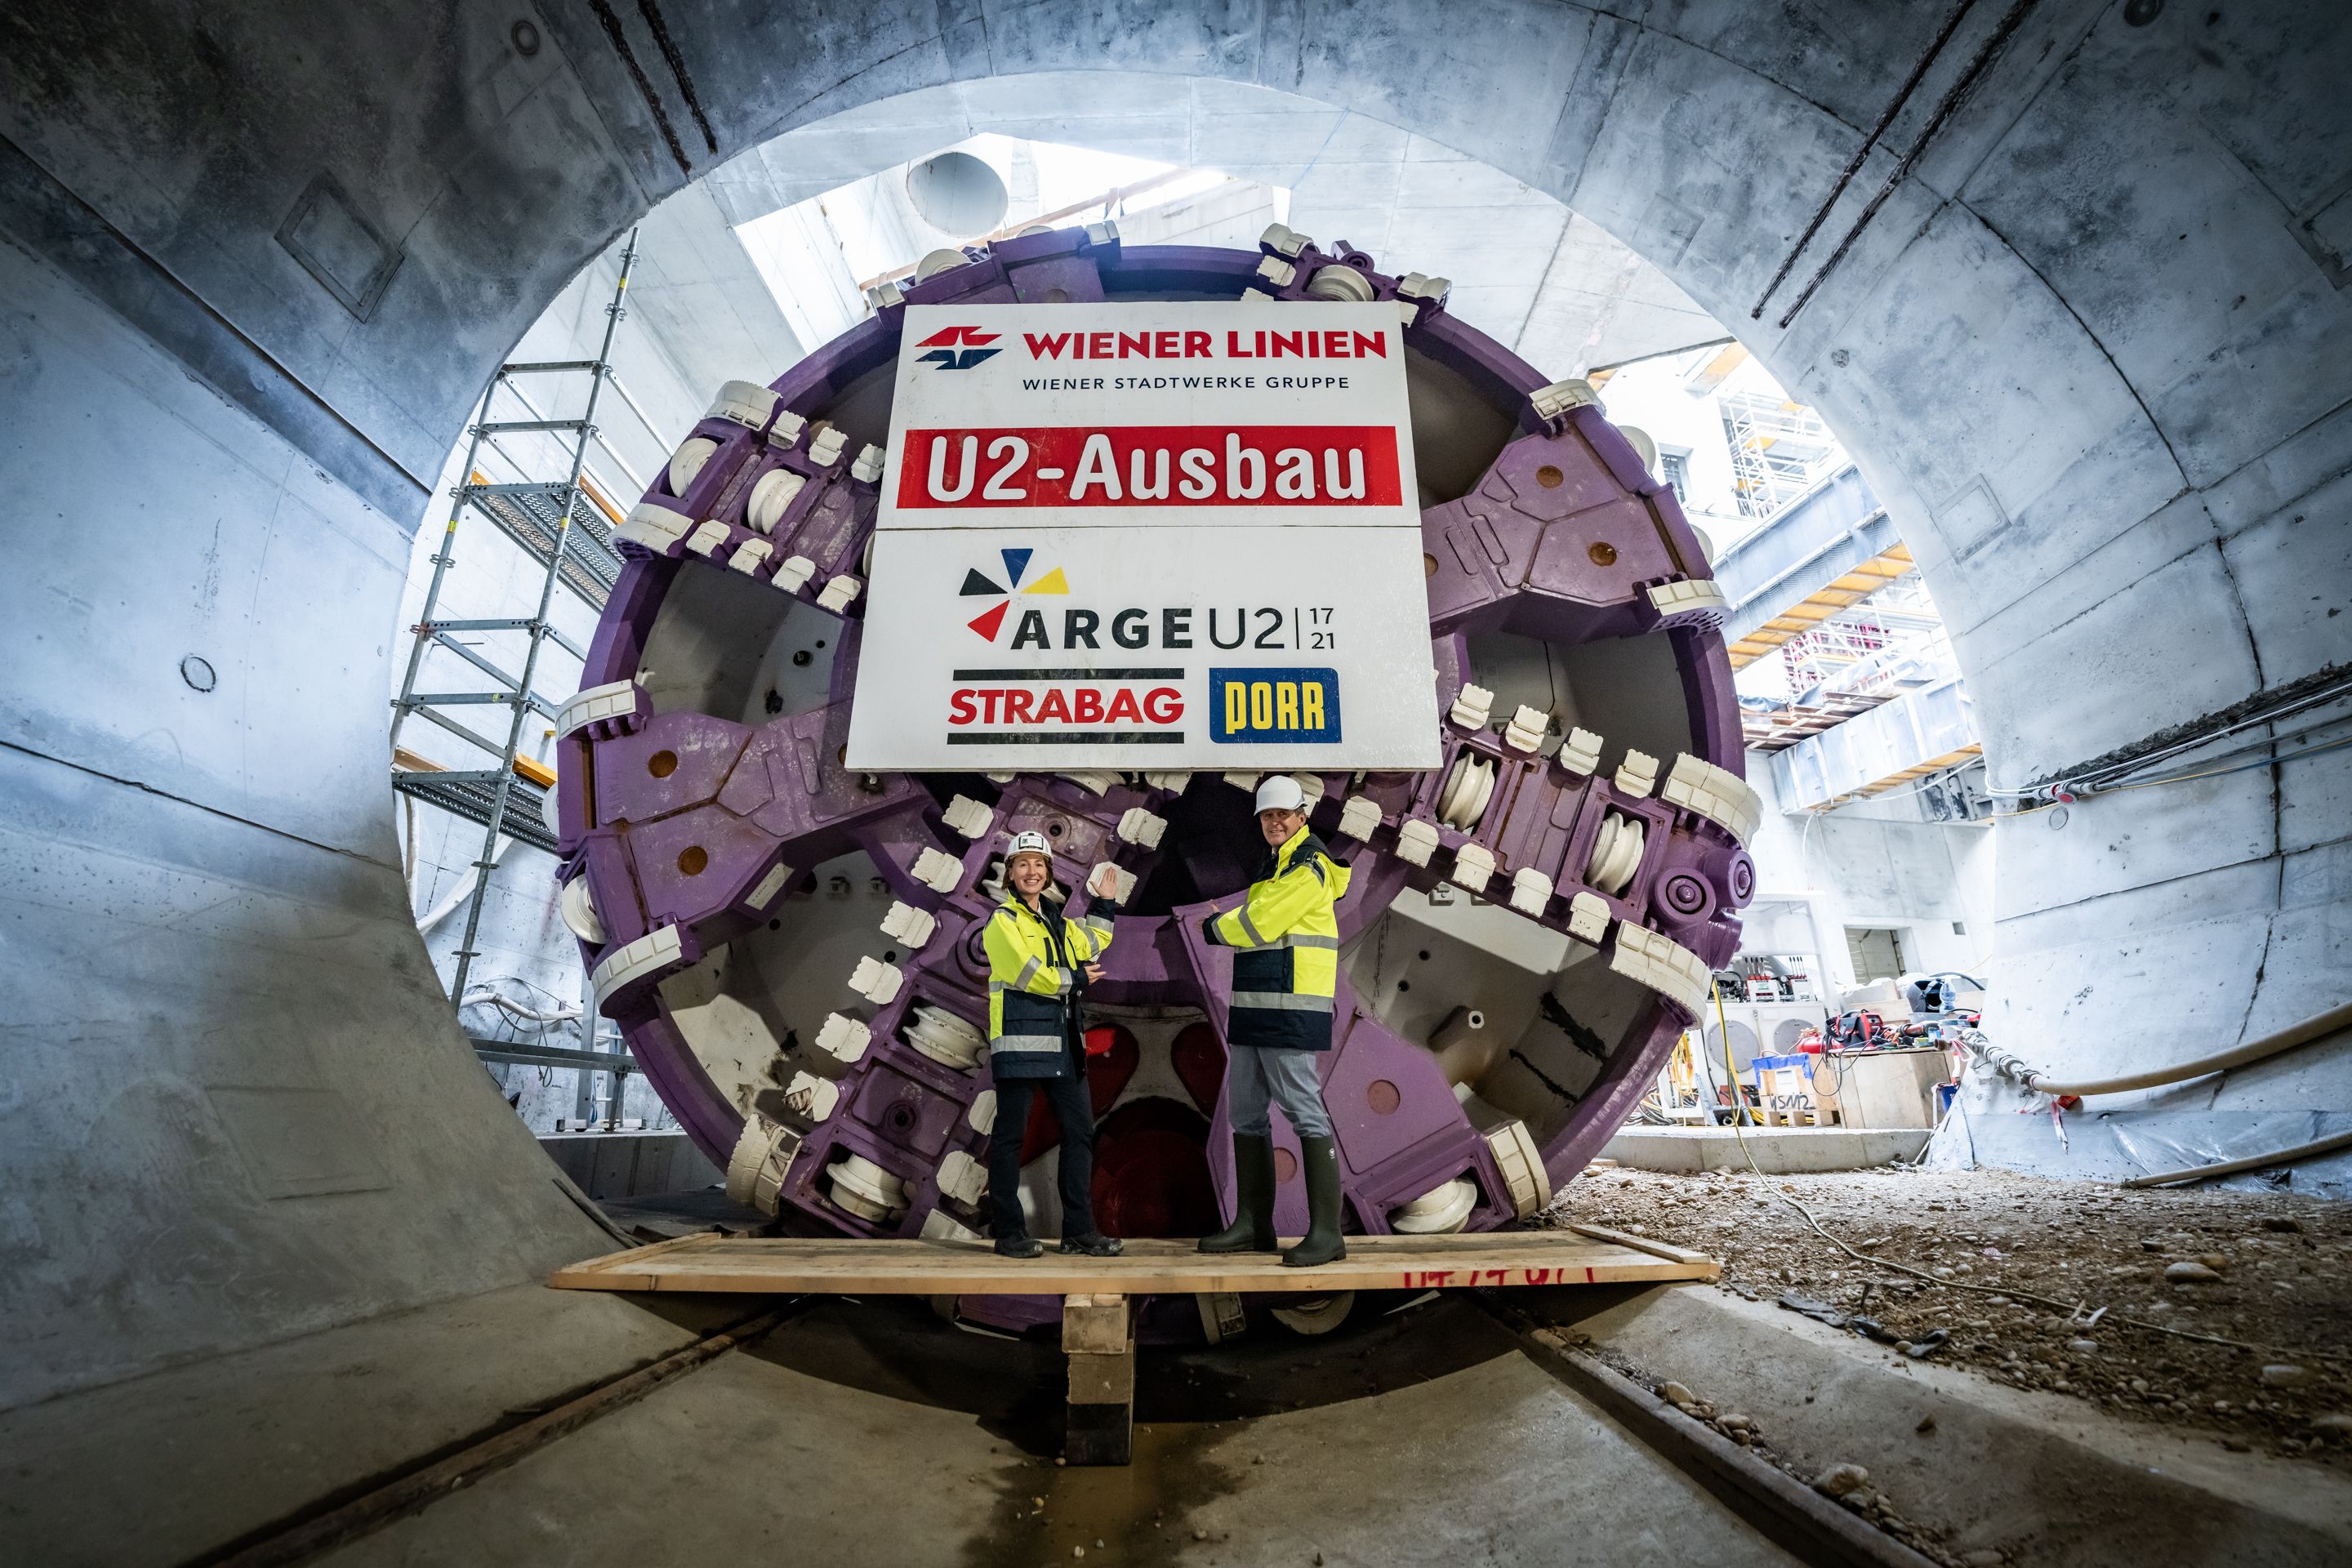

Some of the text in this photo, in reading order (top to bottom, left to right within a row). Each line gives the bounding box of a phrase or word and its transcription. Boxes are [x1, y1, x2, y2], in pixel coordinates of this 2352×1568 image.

[1022, 330, 1387, 361] WIENER LINIEN
[1022, 376, 1350, 390] WIENER STADTWERKE GRUPPE
[927, 432, 1365, 502] U2-Ausbau
[1009, 607, 1334, 650] ARGE U2 17
[1311, 631, 1335, 650] 21
[947, 681, 1325, 734] STRABAG PORR
